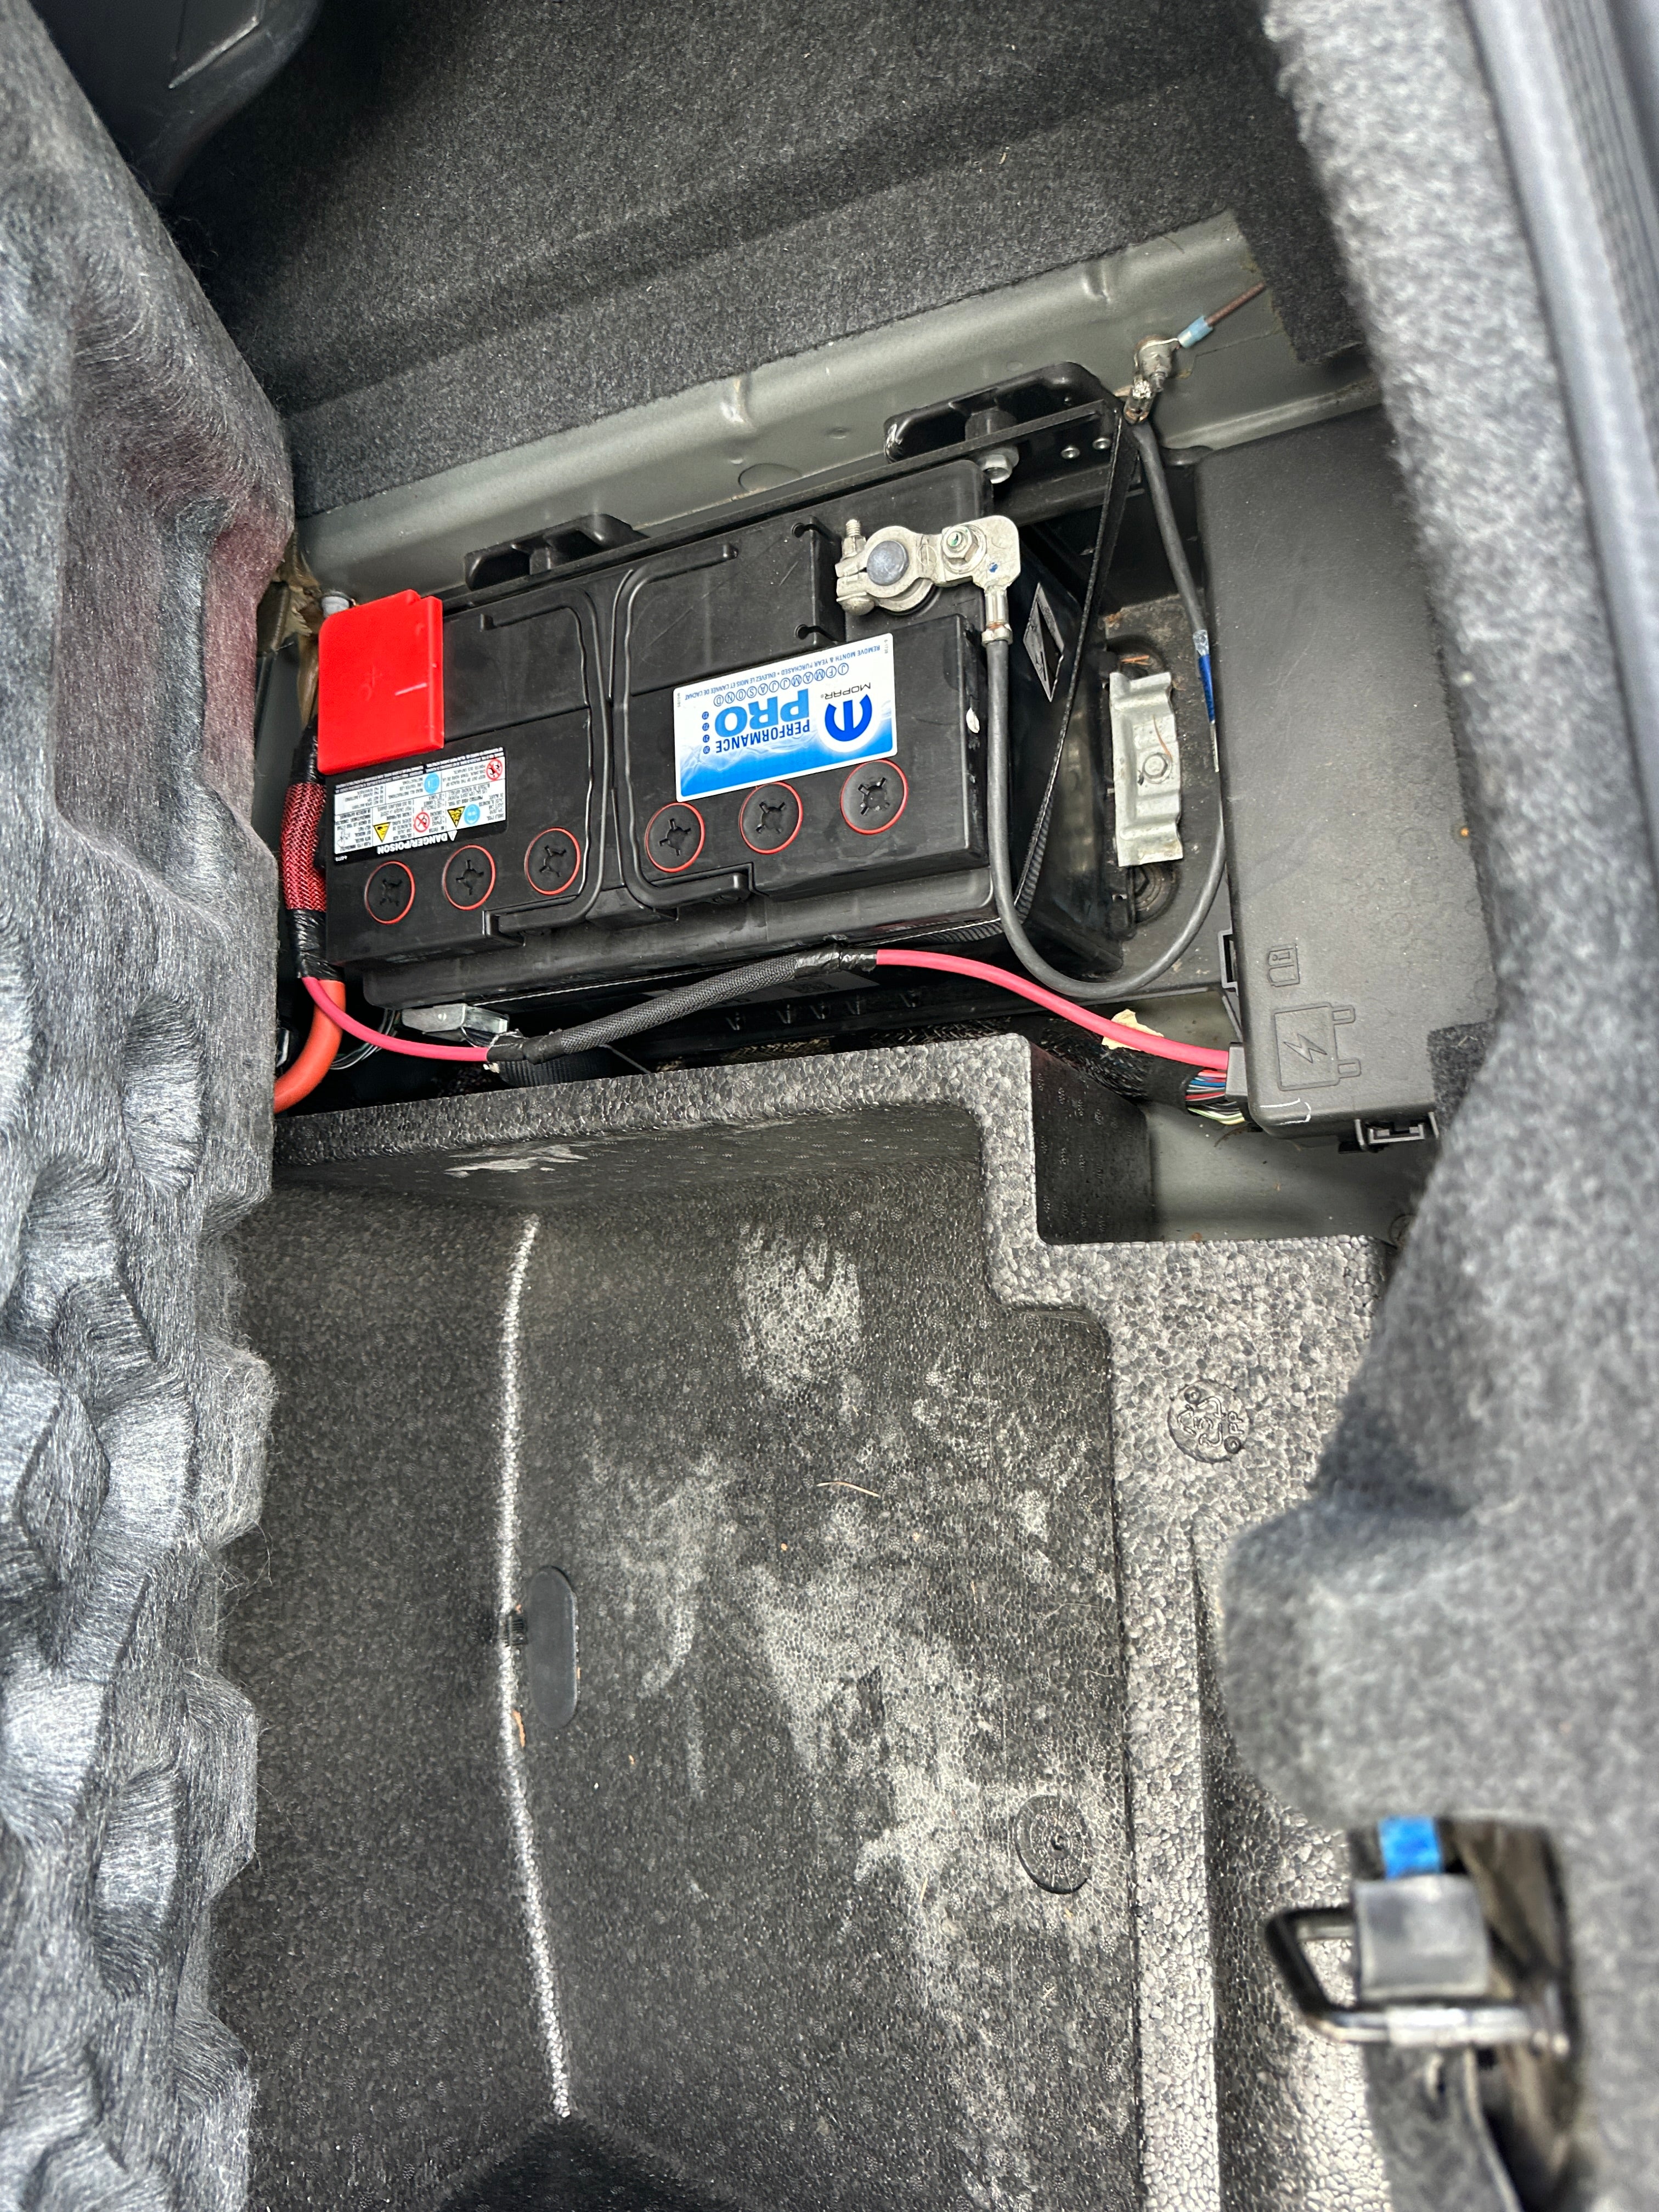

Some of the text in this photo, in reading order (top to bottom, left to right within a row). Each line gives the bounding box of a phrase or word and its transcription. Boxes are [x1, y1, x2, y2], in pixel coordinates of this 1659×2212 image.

[835, 651, 856, 662] MONTH
[857, 645, 881, 656] REMOVE
[814, 658, 828, 667] YEAR
[781, 663, 813, 676] PURCHASED
[736, 679, 749, 687] MOIS
[755, 672, 776, 682] ENLEVEZ
[714, 689, 809, 737] PRO
[716, 719, 810, 753] PERFORMANCE
[377, 832, 448, 855] DANGER/POISON
[1227, 1410, 1245, 1435] PP
